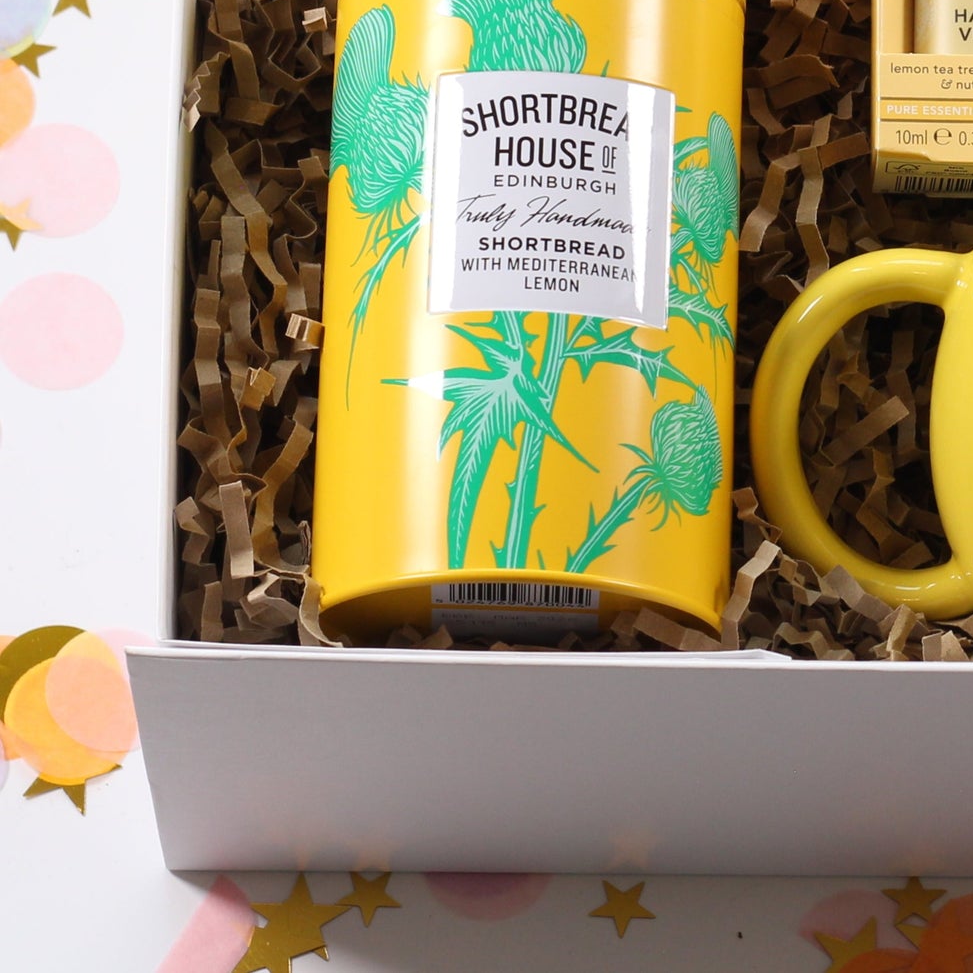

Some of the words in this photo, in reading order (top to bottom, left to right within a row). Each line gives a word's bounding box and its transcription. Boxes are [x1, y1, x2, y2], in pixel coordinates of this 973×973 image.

[890, 63, 929, 74] lemon
[934, 64, 953, 75] tea
[940, 79, 952, 90] &
[461, 93, 629, 142] SHORTBREA
[886, 104, 918, 115] PURE
[895, 129, 928, 145] 10ml
[494, 136, 595, 171] HOUSE
[602, 145, 617, 173] OF
[494, 174, 616, 195] EDINBURGH
[456, 193, 517, 231] Truly
[479, 237, 626, 259] SHORTBREAD
[461, 257, 501, 271] WITH
[524, 276, 579, 292] LEMON
